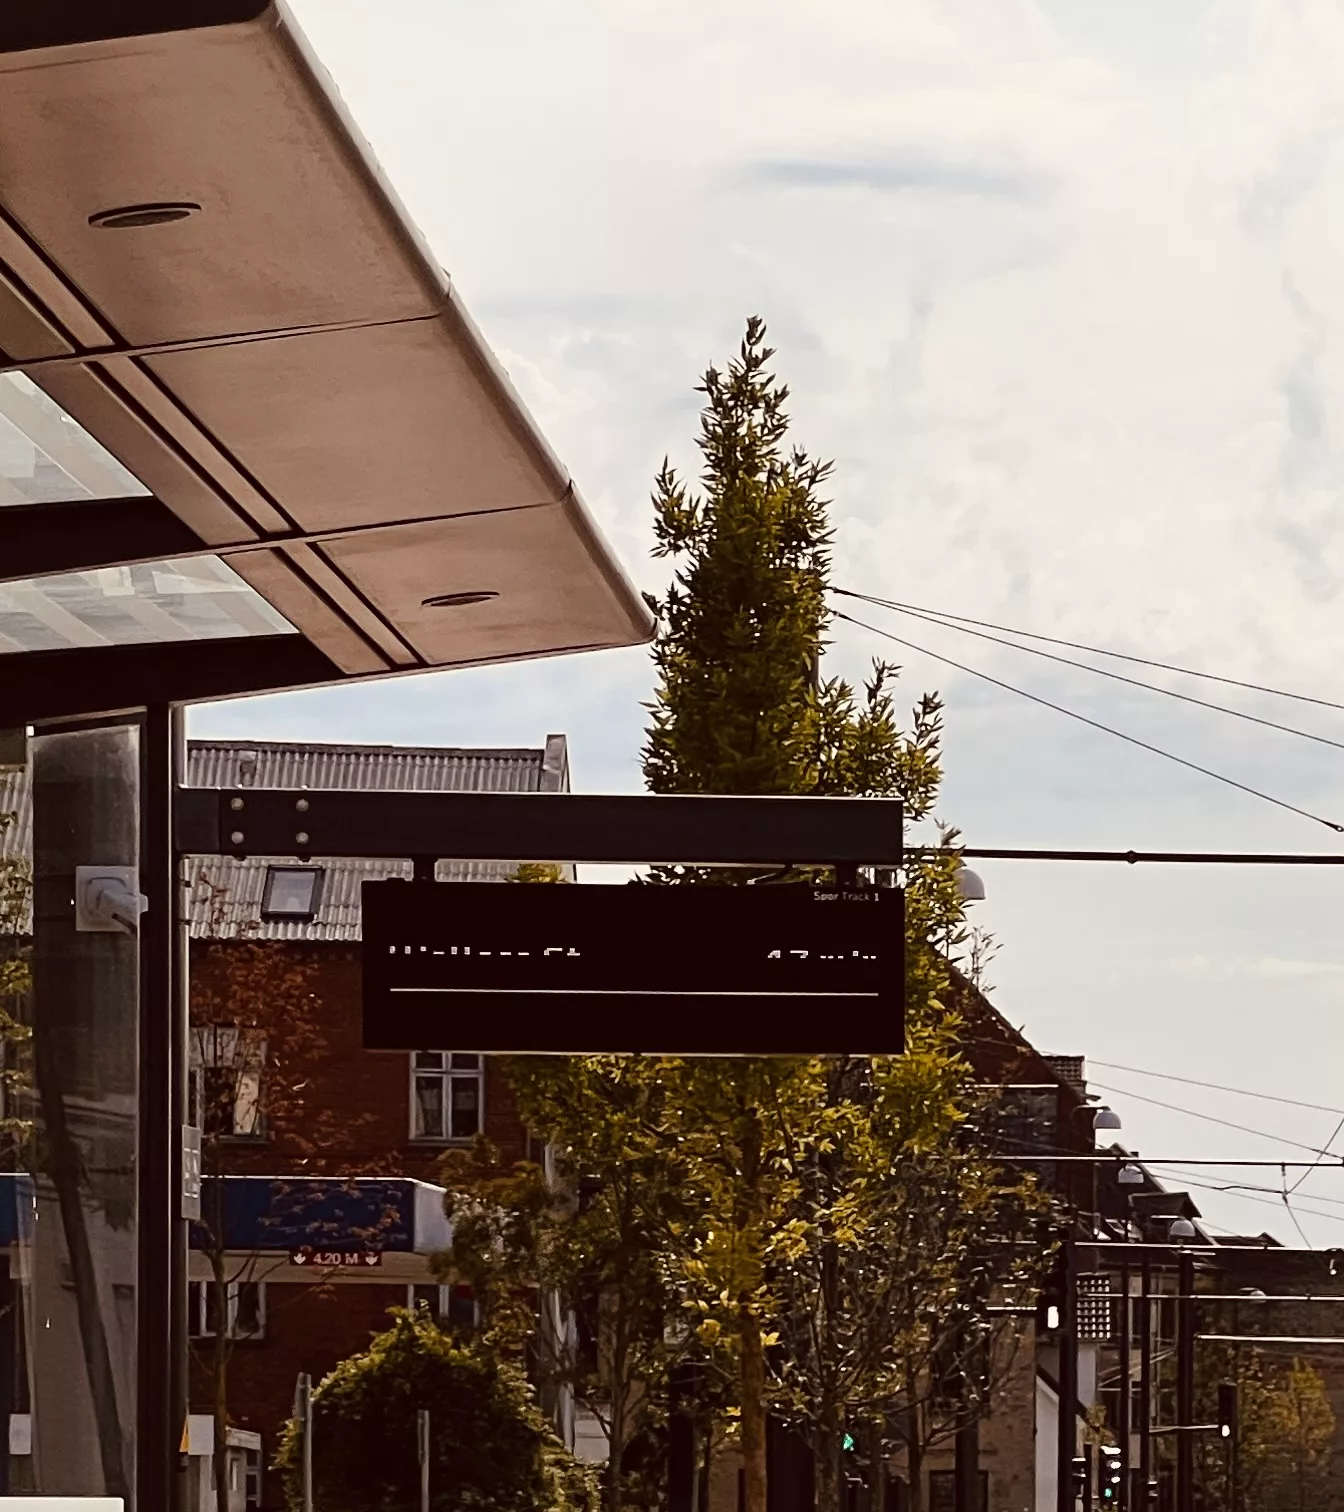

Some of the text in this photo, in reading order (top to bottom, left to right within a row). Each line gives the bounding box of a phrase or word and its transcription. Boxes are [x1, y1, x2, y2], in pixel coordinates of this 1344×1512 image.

[813, 890, 880, 902] Spor Track 1
[345, 1252, 359, 1264] M
